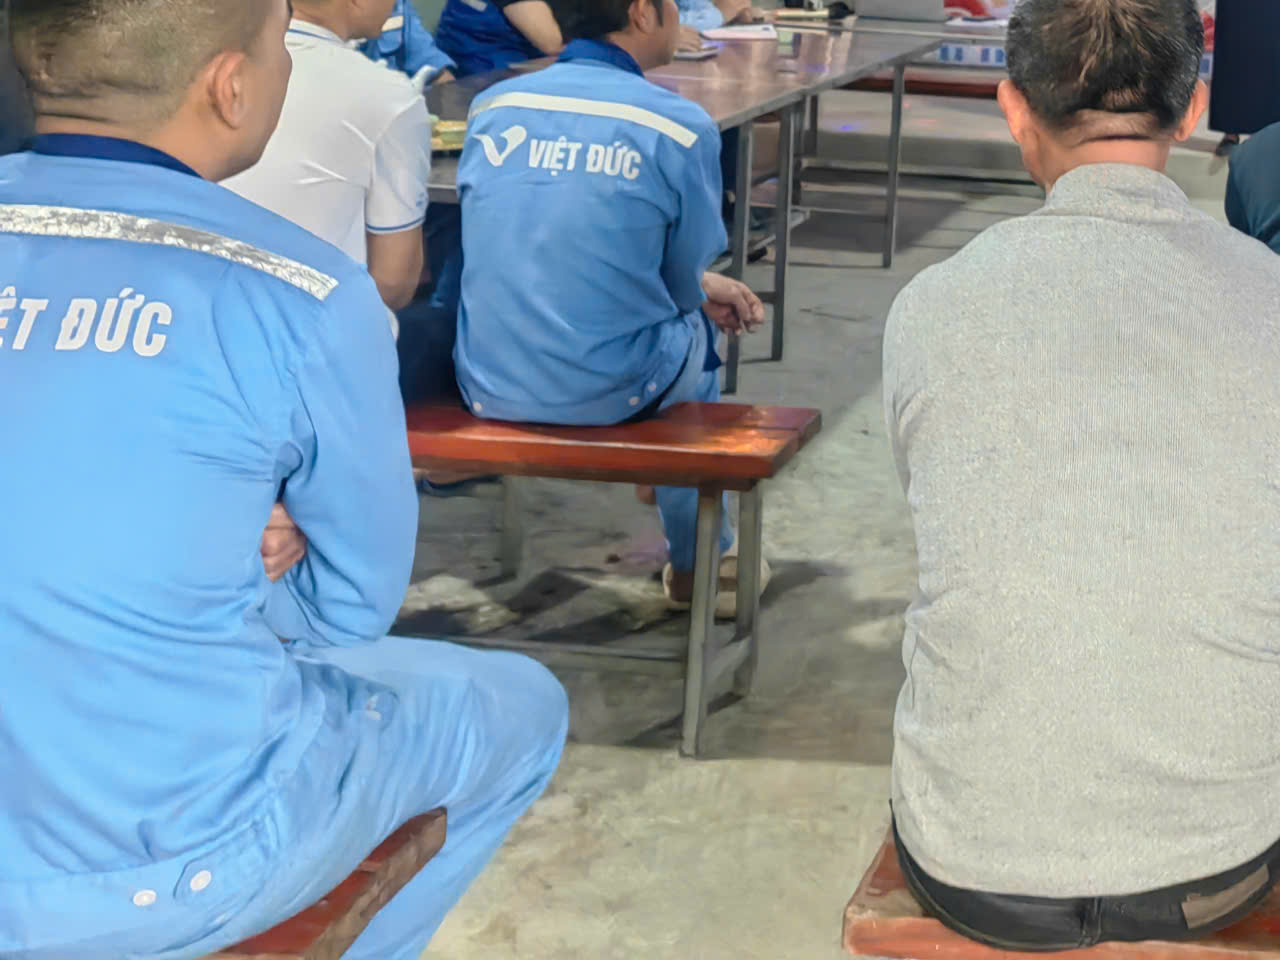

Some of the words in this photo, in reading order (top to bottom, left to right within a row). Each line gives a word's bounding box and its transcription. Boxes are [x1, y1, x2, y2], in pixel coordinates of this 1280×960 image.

[528, 135, 582, 176] VIỆT
[585, 141, 641, 180] ĐỨC
[55, 287, 172, 357] ĐỨC
